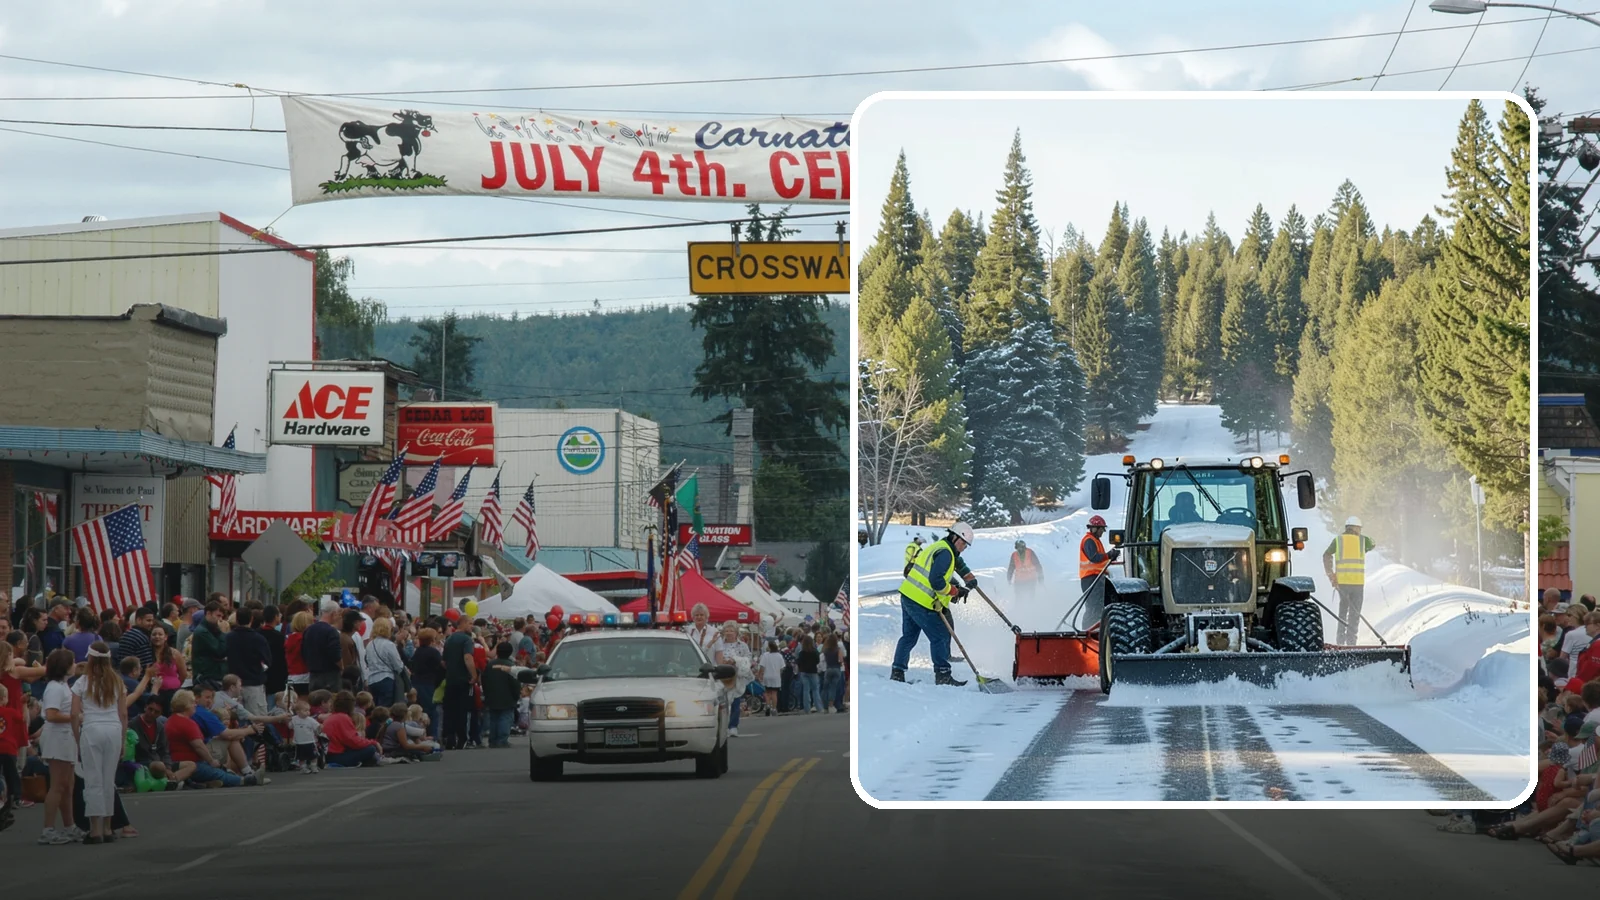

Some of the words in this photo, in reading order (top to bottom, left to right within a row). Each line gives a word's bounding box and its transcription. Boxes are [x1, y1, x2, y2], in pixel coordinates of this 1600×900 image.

[481, 141, 605, 192] JULY
[632, 150, 746, 198] 4th.
[697, 254, 850, 280] CROSSWA
[282, 380, 374, 420] ACE
[405, 409, 452, 422] CEDAR
[460, 409, 485, 422] LOG
[283, 421, 371, 436] Hardware
[416, 428, 477, 447] Coca-Cola
[353, 467, 385, 480] Simpl
[95, 485, 124, 494] Vincent
[126, 486, 136, 495] de
[137, 486, 155, 495] Paul
[688, 526, 741, 535] CRNATION
[699, 535, 730, 543] GLASS
